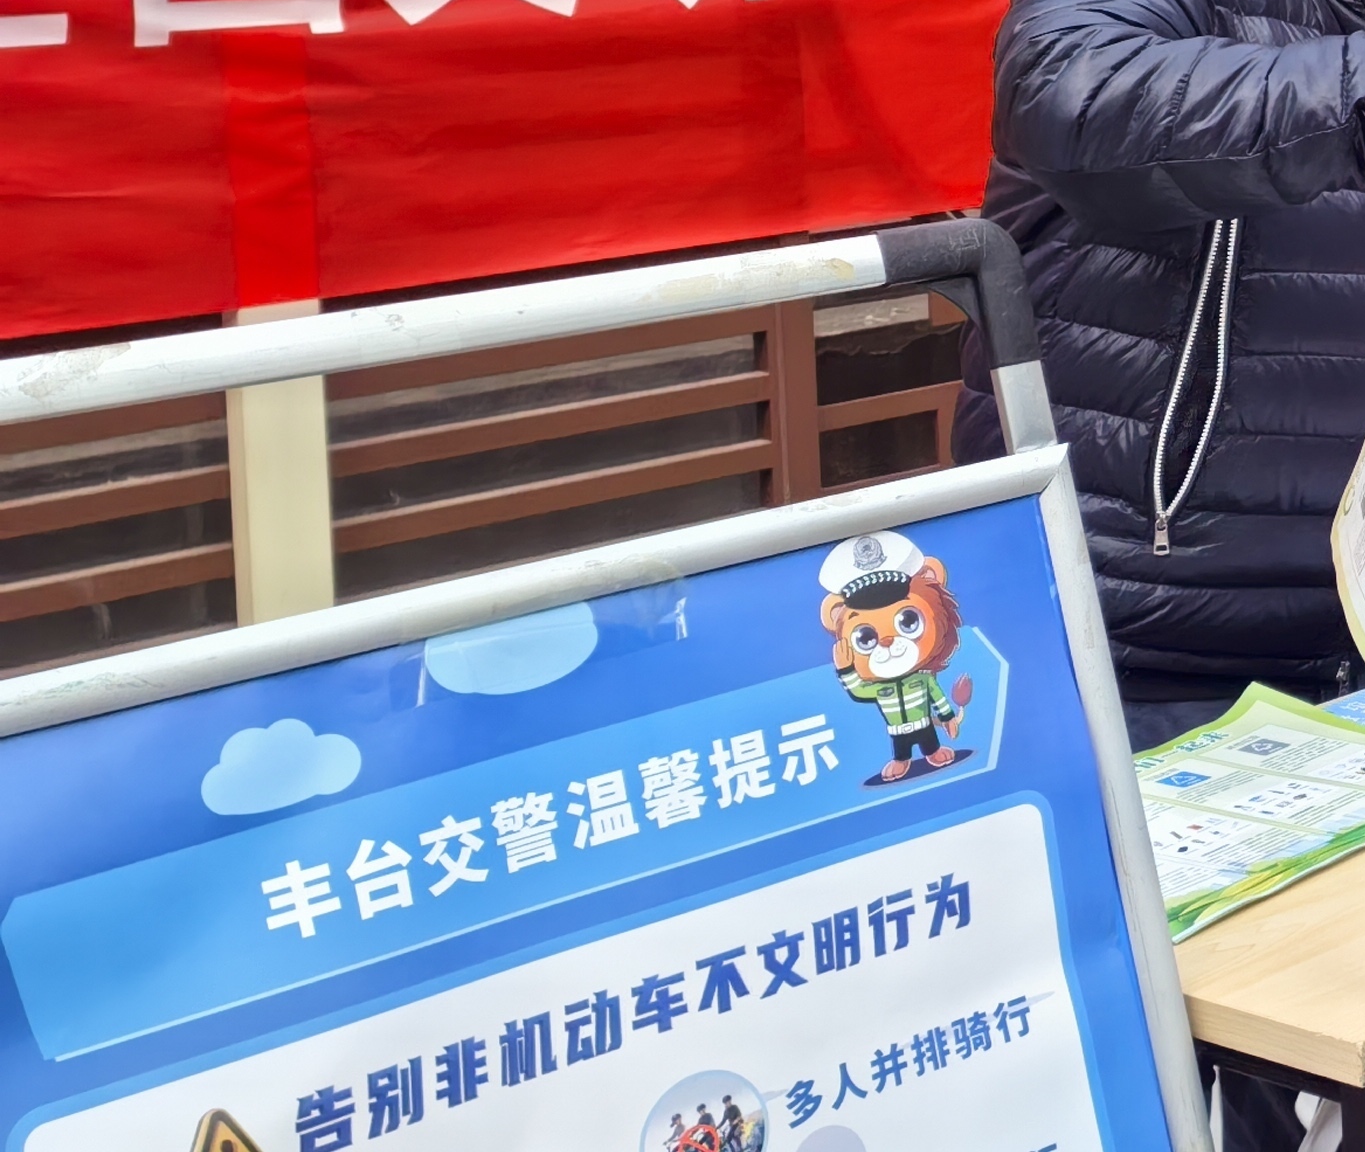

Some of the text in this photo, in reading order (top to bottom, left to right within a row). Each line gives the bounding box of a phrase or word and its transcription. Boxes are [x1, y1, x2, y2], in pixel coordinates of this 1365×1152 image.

[259, 712, 841, 940] 丰台交警温馨提示
[294, 873, 973, 1152] 告别非机动车不文明行为
[784, 995, 1033, 1130] 多人并排骑行
